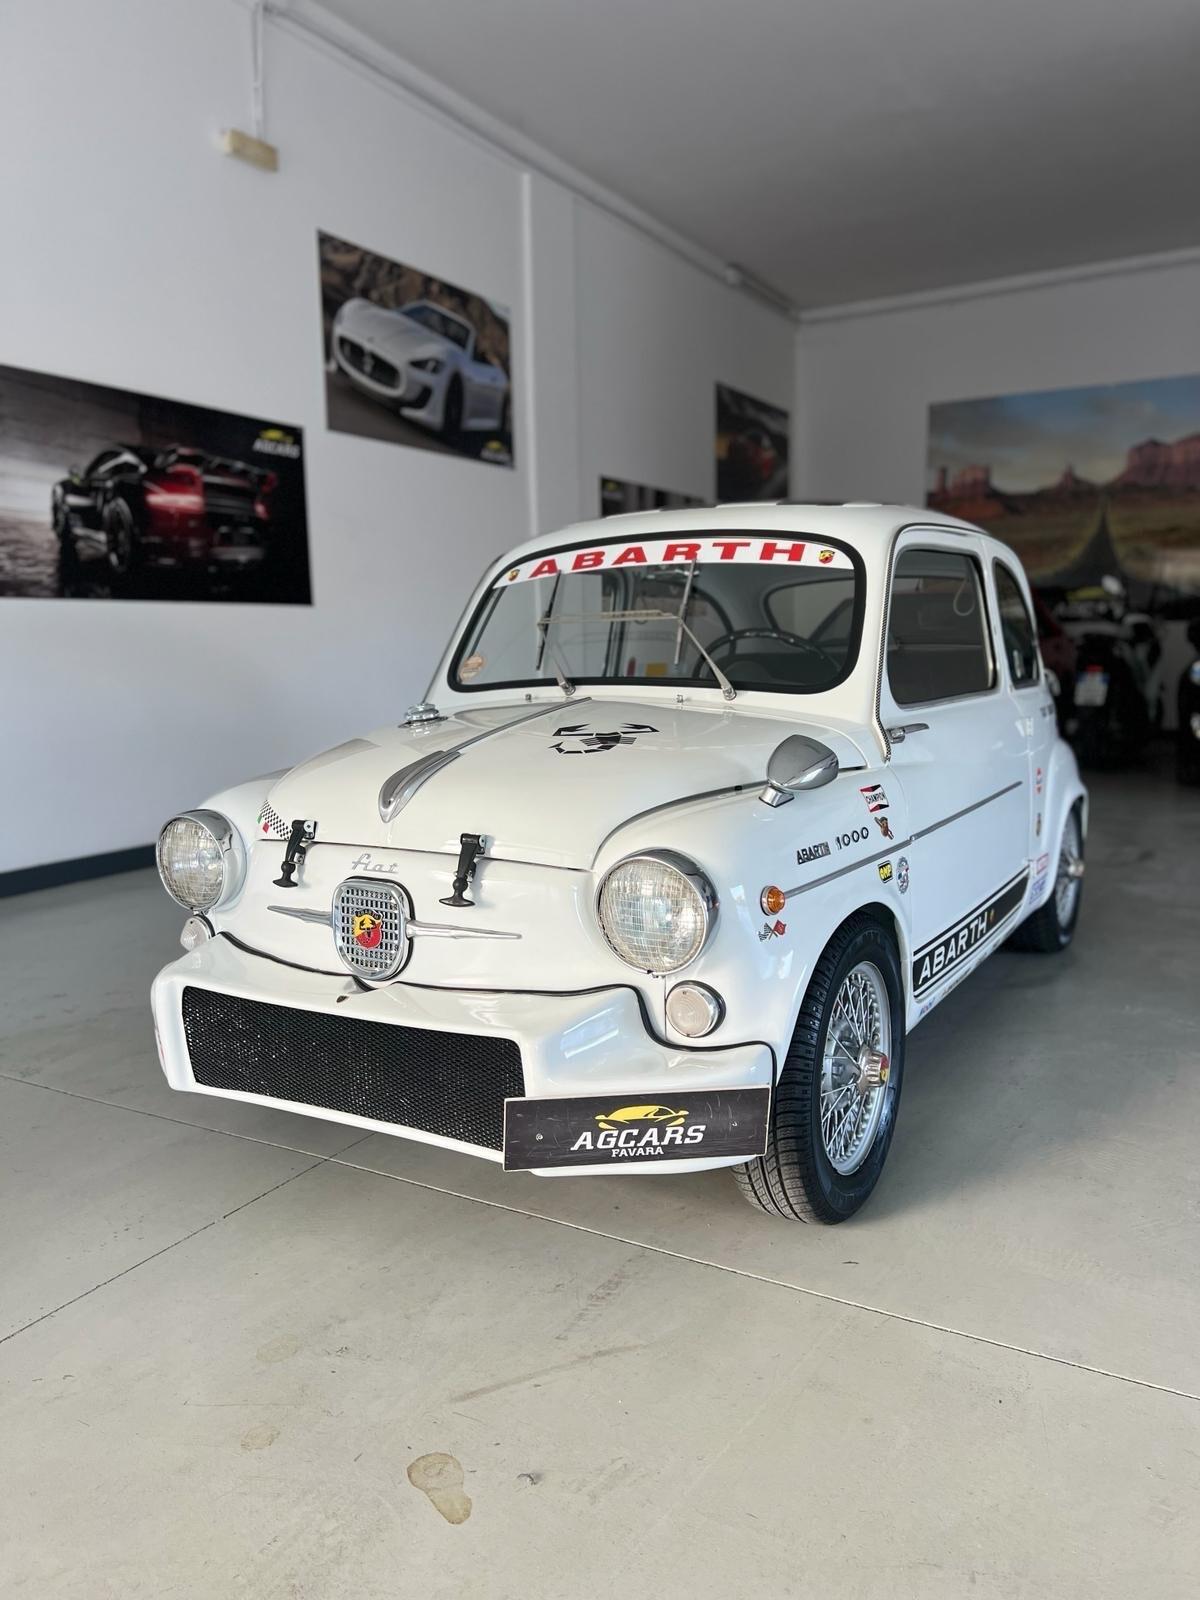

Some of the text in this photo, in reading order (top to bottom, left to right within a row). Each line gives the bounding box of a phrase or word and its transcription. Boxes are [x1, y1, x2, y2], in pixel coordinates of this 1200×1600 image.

[528, 542, 806, 579] ABARTH
[796, 826, 869, 865] ABARTH 1000
[919, 911, 988, 985] ABARTH
[570, 1124, 706, 1151] AGCARS
[611, 1146, 664, 1158] FAVARA
